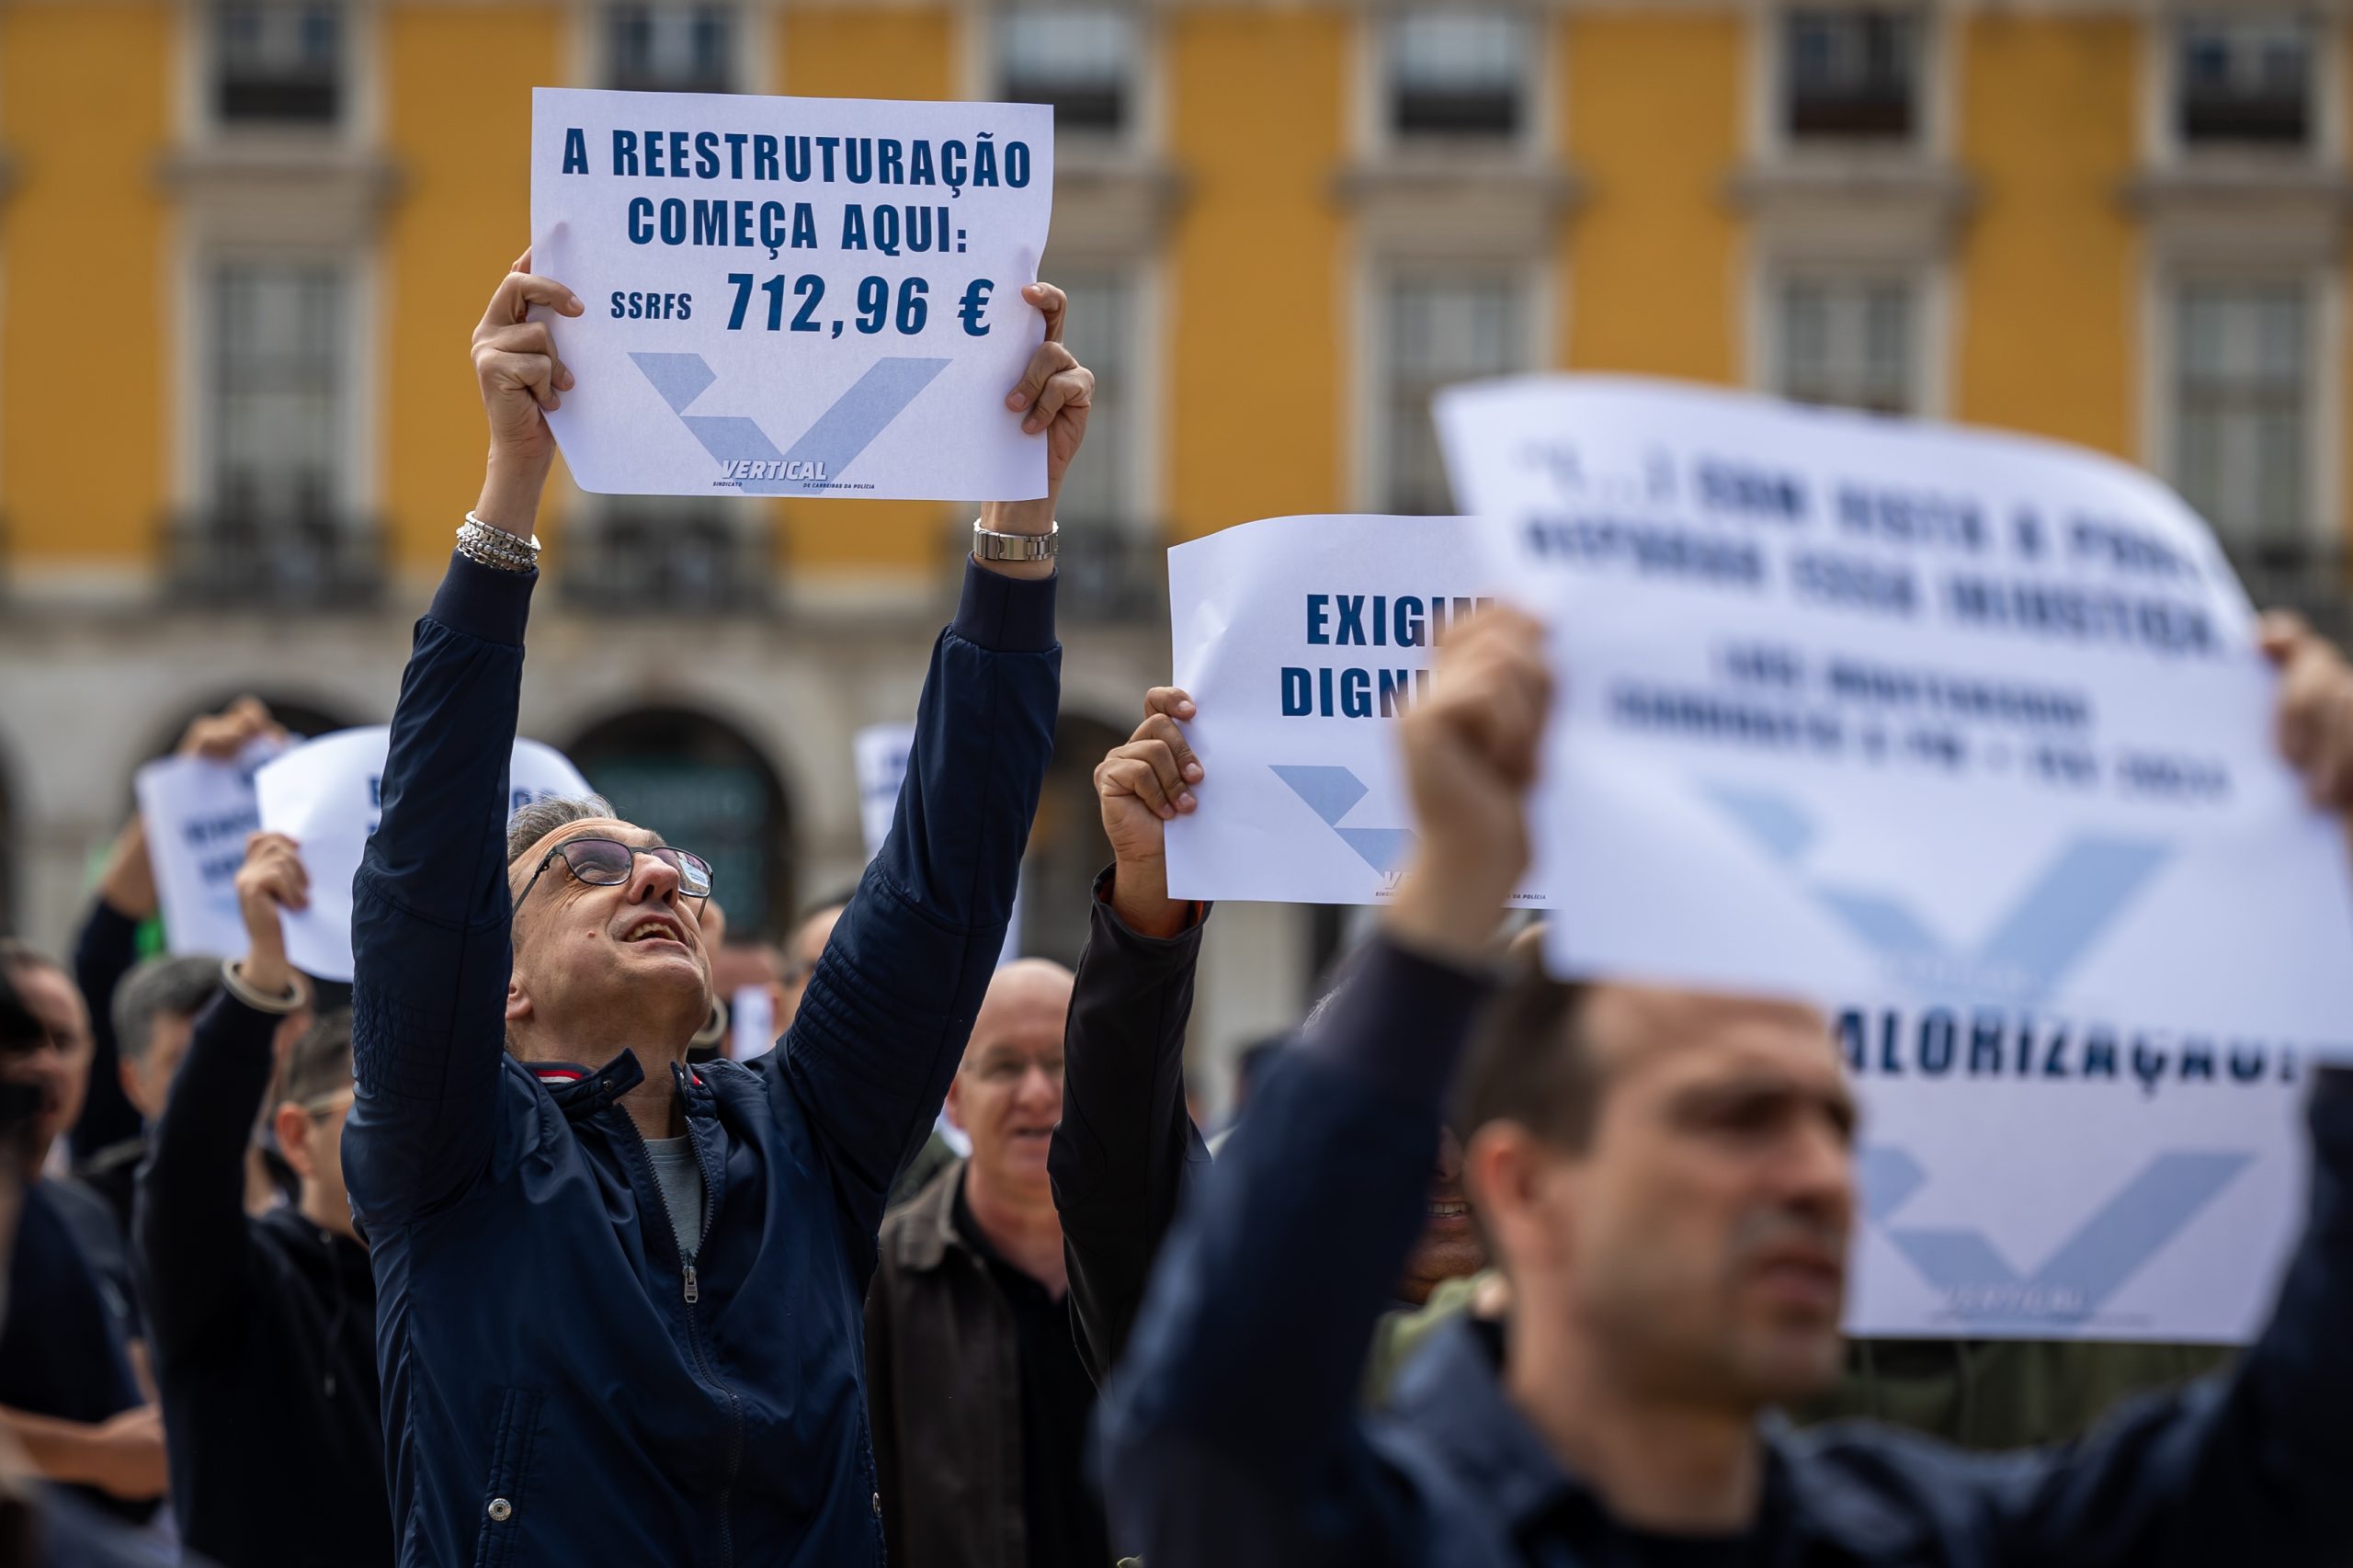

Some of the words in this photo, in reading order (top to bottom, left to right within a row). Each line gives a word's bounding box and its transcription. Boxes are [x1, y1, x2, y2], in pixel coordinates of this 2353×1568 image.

[563, 128, 589, 175] A
[612, 130, 1032, 199] REESTRUTURAÇÃO
[628, 197, 818, 260] COMEÇA
[841, 203, 968, 256] AQUI:
[610, 290, 692, 321] SSRFS
[726, 273, 930, 339] 712,96
[957, 278, 995, 337] €
[722, 460, 828, 482] VERTICAL
[1307, 594, 1495, 647] EXIGIM
[1281, 667, 1438, 718] DIGNI
